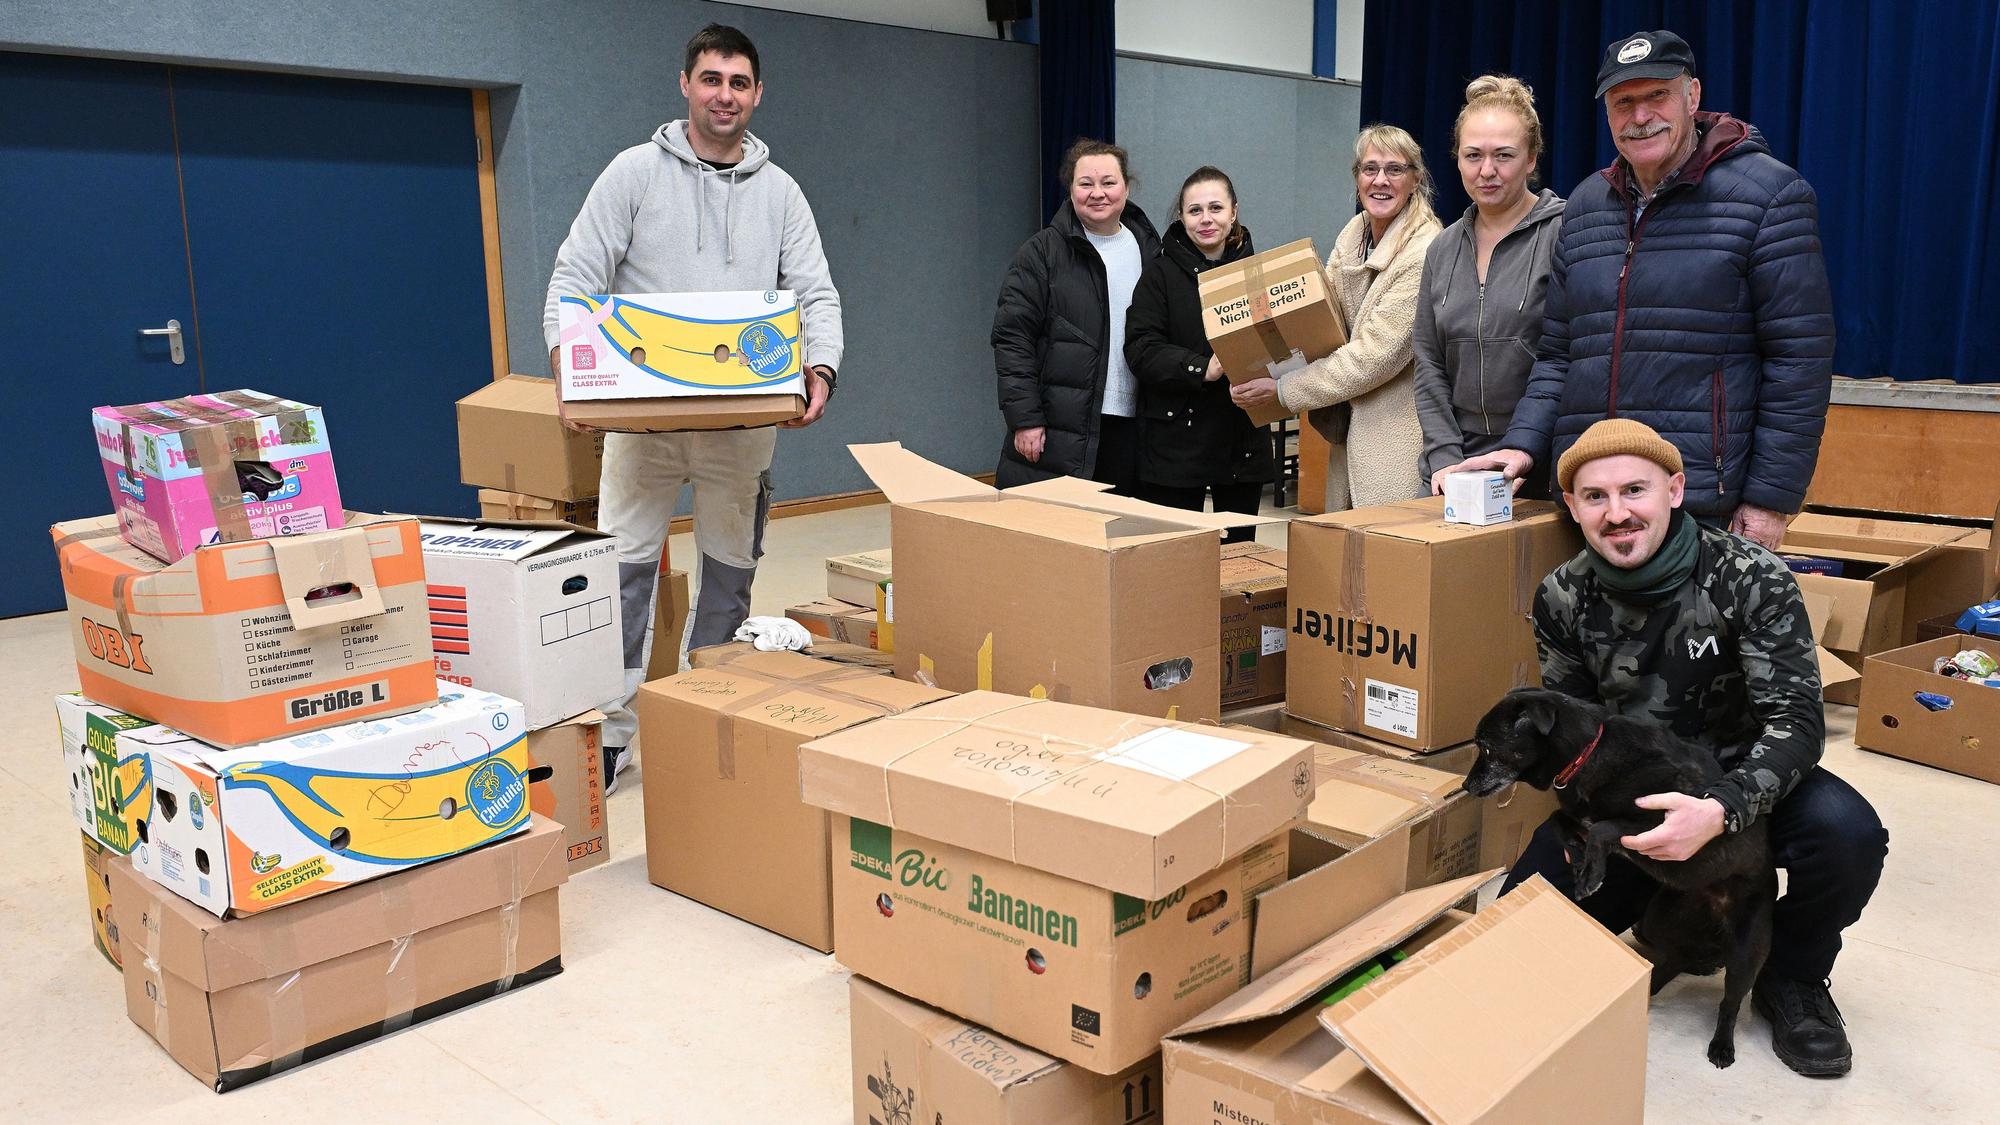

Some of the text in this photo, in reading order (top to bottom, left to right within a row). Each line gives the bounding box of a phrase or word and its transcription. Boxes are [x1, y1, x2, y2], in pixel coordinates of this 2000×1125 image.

[1270, 280, 1299, 296] Glas
[1220, 289, 1306, 326] Nich erfen!
[749, 341, 790, 372] Chiquita
[289, 459, 305, 469] dm
[266, 502, 293, 517] plus
[429, 535, 532, 550] OPENEN
[527, 552, 582, 573] VERVANGINGSWAARDE
[1252, 601, 1282, 612] PRODUCT
[252, 613, 291, 626] Wohnzim
[350, 623, 373, 633] Keller
[352, 634, 379, 646] Garage
[1223, 627, 1251, 640] ANIC
[1292, 608, 1417, 670] McFilter
[81, 616, 153, 675] OBI
[256, 640, 281, 650] Küche
[257, 646, 312, 663] Schlafzimmer
[259, 659, 314, 675] Kinderzimmer
[433, 655, 451, 672] fe
[261, 671, 313, 687] Gästezimmer
[291, 683, 385, 719] Größe L
[88, 727, 116, 758] GOLDE
[480, 779, 524, 825] Chiquita
[97, 817, 128, 850] BANAN
[567, 836, 602, 862] BI
[256, 858, 321, 890] SELECTED QUALITY
[262, 866, 324, 897] CLASS EXTRA
[851, 851, 893, 875] EDEKA
[968, 873, 1078, 948] Bananen
